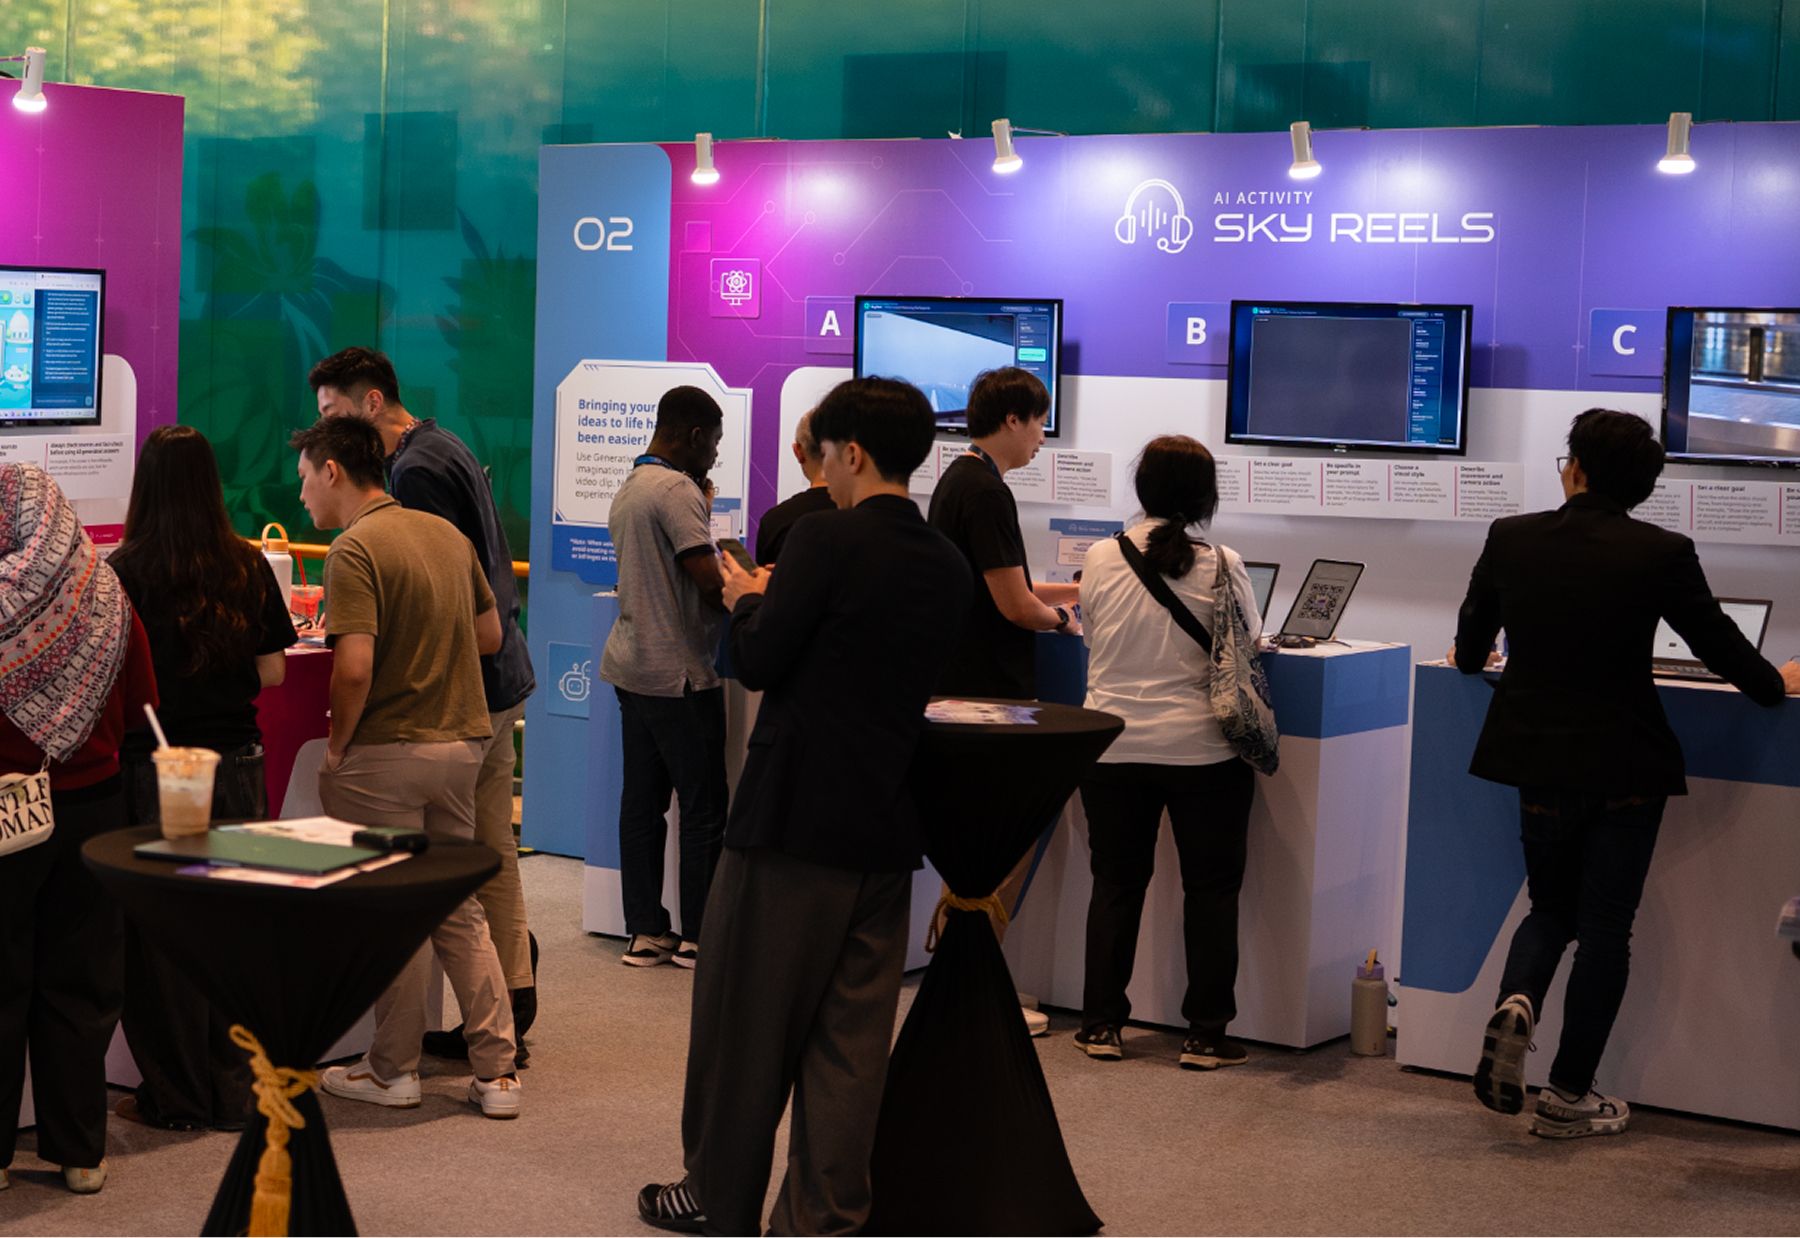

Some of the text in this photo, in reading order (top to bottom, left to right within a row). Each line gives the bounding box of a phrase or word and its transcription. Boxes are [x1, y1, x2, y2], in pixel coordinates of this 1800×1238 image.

[1213, 191, 1313, 205] AI ACTIVITY
[573, 216, 634, 251] 02
[1213, 212, 1495, 243] SKY REELS
[819, 309, 841, 337] A
[1186, 317, 1207, 345] B
[1612, 324, 1638, 355] C
[578, 399, 656, 415] Bringing your
[577, 415, 608, 427] ideas
[611, 417, 622, 428] to
[625, 416, 643, 430] life
[577, 431, 647, 446] been easier!
[576, 452, 592, 462] Use
[576, 465, 625, 476] imagination
[576, 477, 598, 487] video
